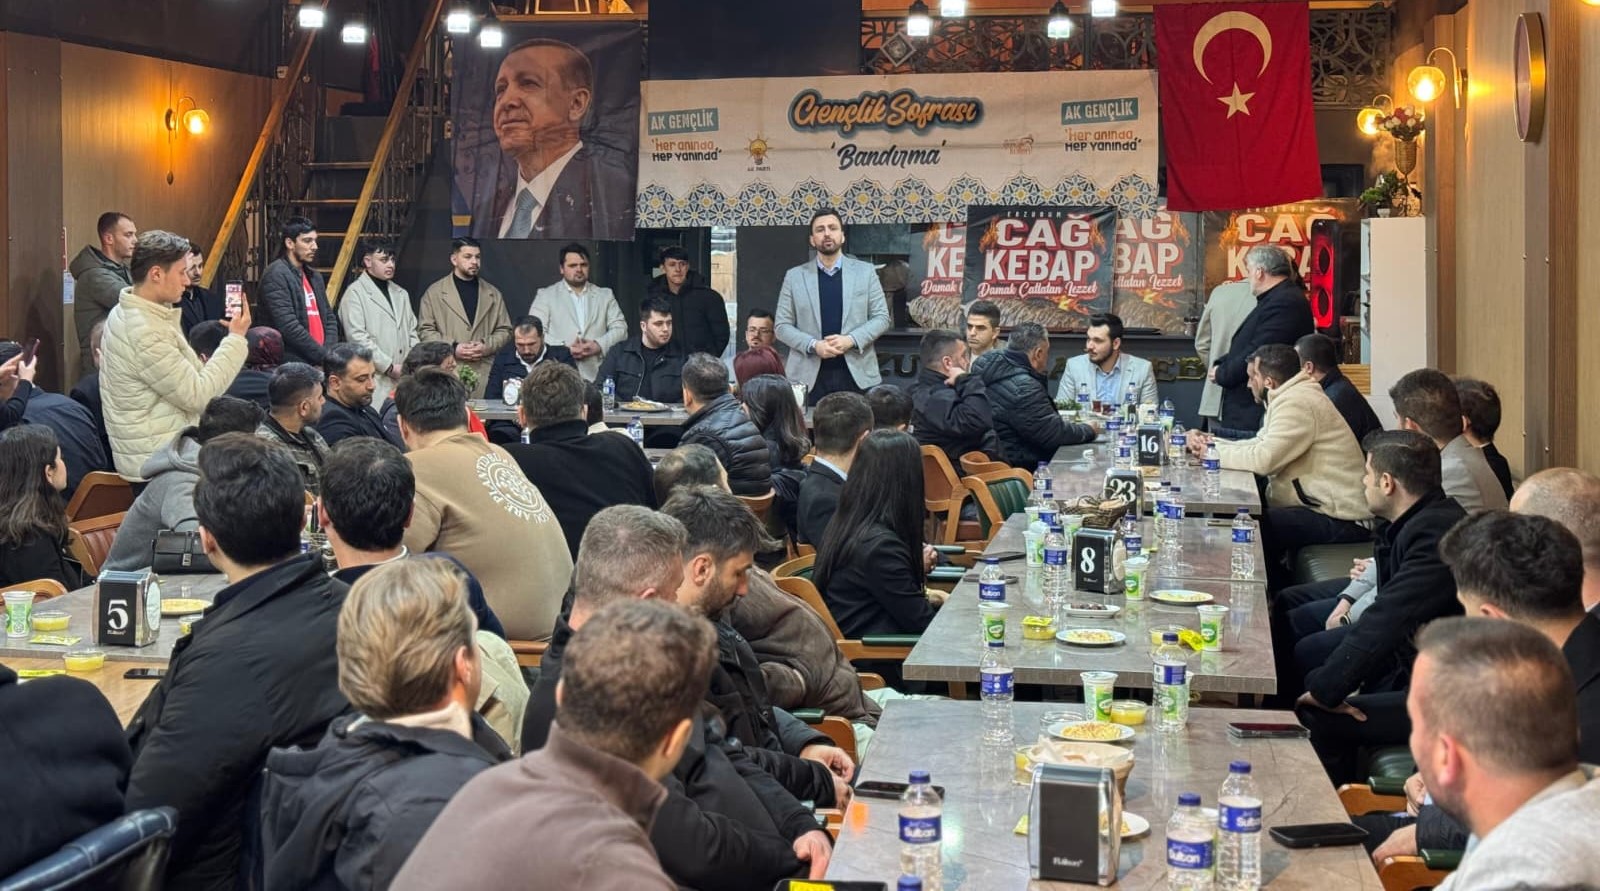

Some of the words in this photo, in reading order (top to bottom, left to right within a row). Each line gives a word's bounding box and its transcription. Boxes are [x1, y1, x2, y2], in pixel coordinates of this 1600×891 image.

[651, 115, 666, 131] AK
[668, 109, 714, 132] GENÇLİK
[794, 93, 886, 132] Gençlik
[887, 93, 977, 128] Sofrası
[1065, 105, 1082, 120] AK
[1085, 99, 1134, 121] GENÇLİK
[997, 213, 1090, 247] CAĞ
[984, 249, 1096, 282] KEBAP
[1116, 242, 1179, 275] BAP
[921, 279, 957, 295] Damak
[977, 282, 1017, 298] Damak
[1065, 280, 1098, 297] Lezzet
[1149, 273, 1183, 290] Lezzet
[1140, 434, 1159, 454] 16
[1109, 478, 1136, 502] 23
[1080, 546, 1096, 574] 8
[107, 599, 129, 630] 5
